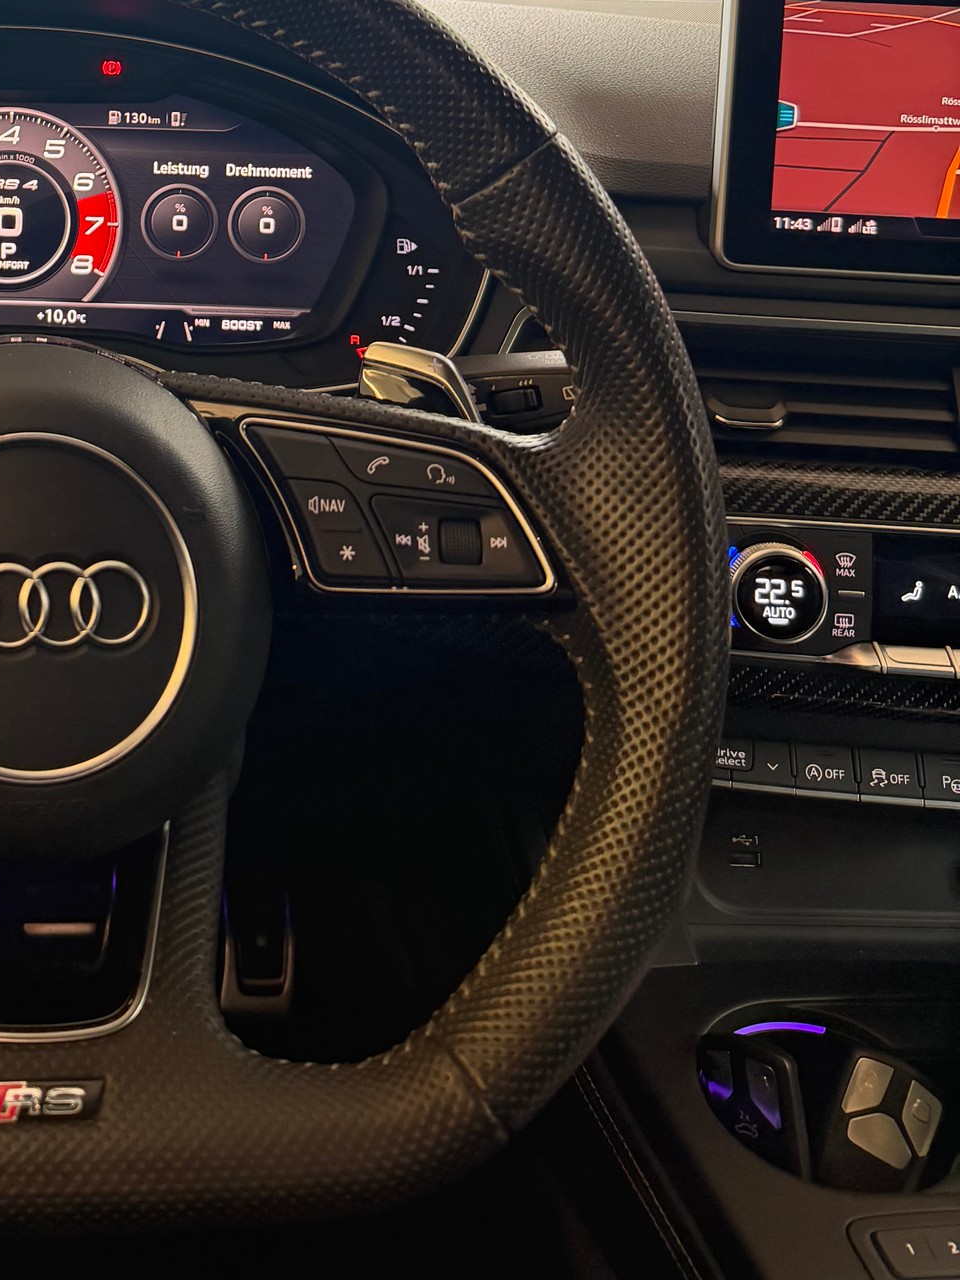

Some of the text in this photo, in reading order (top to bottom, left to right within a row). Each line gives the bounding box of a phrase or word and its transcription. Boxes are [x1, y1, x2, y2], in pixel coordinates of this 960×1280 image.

[123, 112, 147, 124] 130
[0, 125, 21, 144] 4
[43, 139, 66, 159] 5
[15, 153, 35, 164] 1000
[153, 161, 210, 178] Leistung
[226, 163, 313, 179] Drehmoment
[22, 179, 38, 191] 4
[73, 172, 95, 191] 6
[0, 195, 21, 205] km/h
[84, 216, 105, 235] 7
[172, 215, 188, 231] 0
[259, 217, 275, 234] 0
[774, 216, 814, 231] 11:43
[0, 242, 18, 260] P
[71, 255, 93, 275] 8
[407, 266, 423, 275] 1/1
[194, 318, 210, 328] MIN
[221, 319, 263, 331] BOOST
[272, 320, 291, 330] MAX
[381, 316, 401, 327] 1/2
[320, 498, 345, 513] NAV
[835, 568, 855, 577] MAX
[754, 577, 805, 605] 22.5
[763, 605, 796, 619] AUTO
[831, 628, 855, 638] REAR
[824, 768, 845, 780] OFF
[889, 773, 910, 785] OFF
